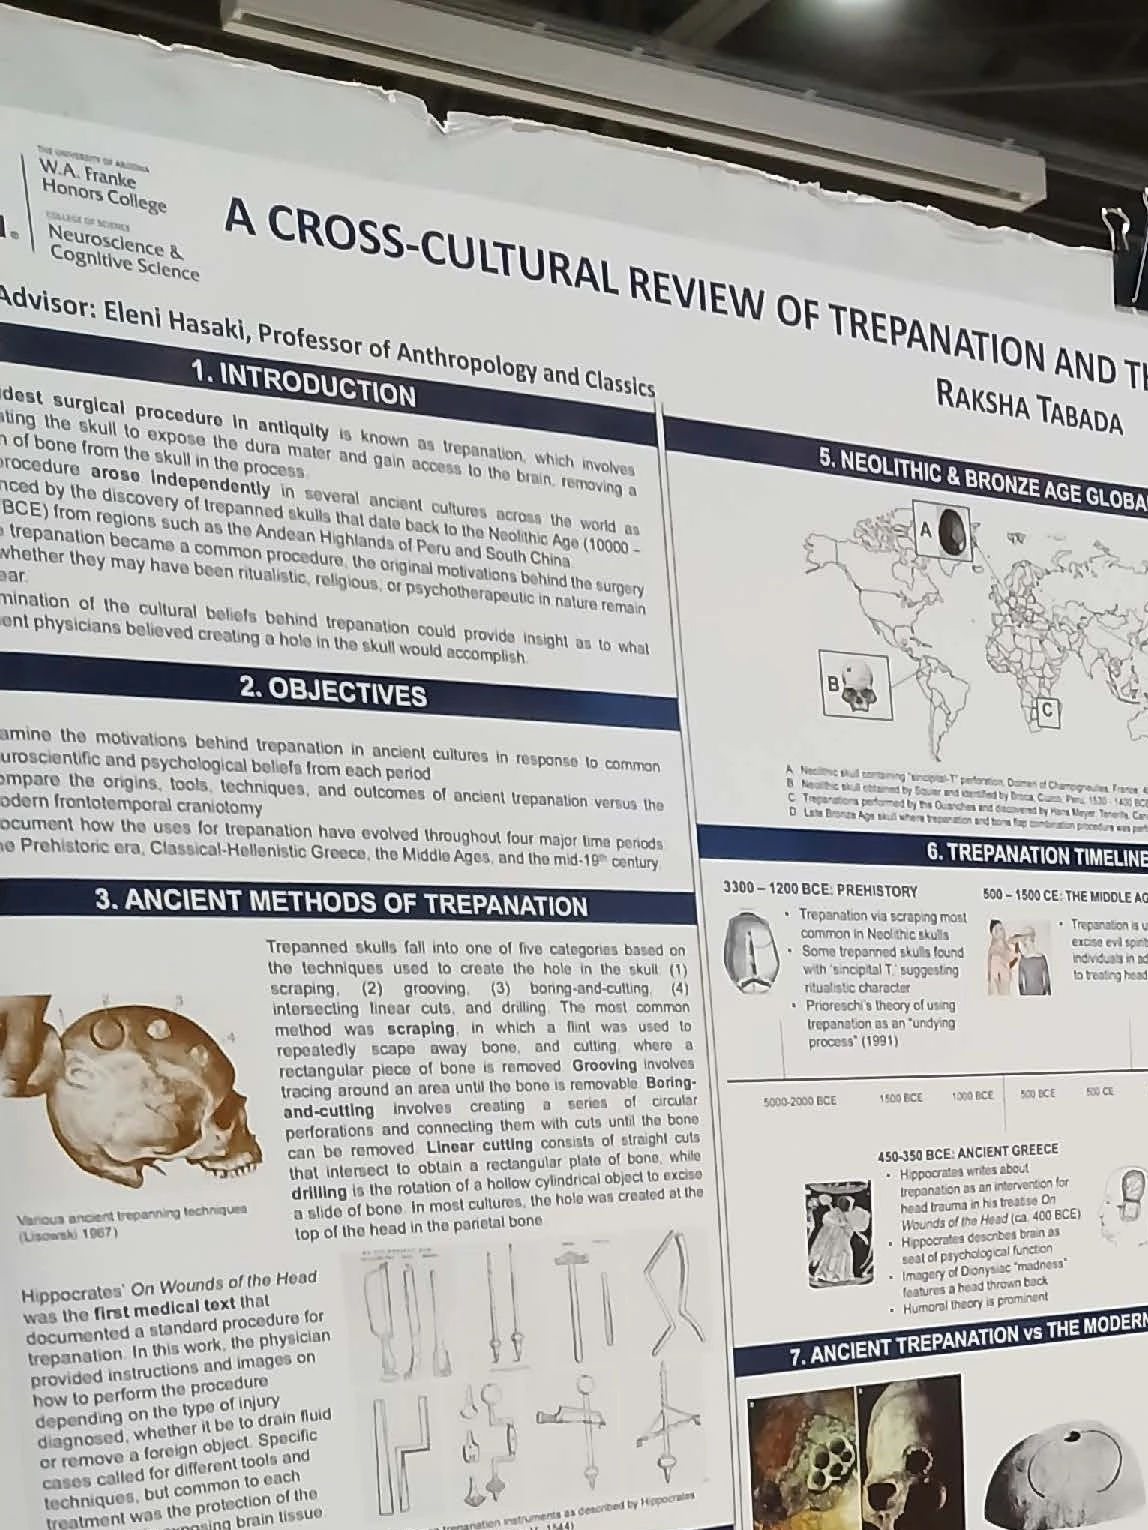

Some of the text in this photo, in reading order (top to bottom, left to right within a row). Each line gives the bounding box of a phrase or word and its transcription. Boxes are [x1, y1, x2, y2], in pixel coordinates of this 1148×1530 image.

[39, 158, 136, 189] W.A. Franke
[43, 178, 166, 215] Honors College
[48, 223, 164, 257] Neuroscience
[170, 245, 184, 261] &
[51, 244, 199, 282] Cognitive Science
[225, 197, 256, 235] A
[269, 205, 619, 295] CROSS-CULTURAL
[630, 266, 764, 320] REVIEW
[778, 295, 819, 330] OF
[828, 303, 1044, 372] TREPANATION
[1055, 347, 1116, 384] AND
[0, 285, 655, 401] Advisor: Eleni Hasaki, Professor of Anthropology and Classics
[192, 359, 415, 407] 1. INTRODUCTION
[937, 378, 1123, 436] RAKSHA TABADA
[53, 396, 124, 415] surgical
[136, 406, 223, 427] procedure
[233, 414, 248, 430] in
[259, 420, 328, 442] antiquity
[340, 429, 352, 441] is
[361, 429, 409, 448] known
[418, 439, 434, 451] as
[535, 453, 574, 468] which
[583, 460, 635, 476] involves
[820, 447, 835, 467] 5.
[841, 450, 941, 482] NEOLITHIC
[947, 466, 960, 486] &
[965, 469, 1040, 497] BRONZE
[1045, 481, 1081, 503] AGE
[920, 522, 932, 538] A
[240, 675, 427, 707] 2. OBJECTIVES
[828, 676, 840, 692] B
[1042, 702, 1053, 717] C
[928, 842, 943, 860] 6.
[947, 842, 1070, 865] TREPANATION
[95, 888, 588, 920] 3. ANCIENT METHODS OF TREPANATION
[724, 880, 754, 893] 3300
[770, 882, 798, 894] 1200
[802, 883, 833, 895] BCE:
[837, 884, 917, 898] PREHISTORY
[984, 888, 1002, 899] 500
[1016, 889, 1040, 901] 1500
[1043, 890, 1062, 901] CE:
[1065, 890, 1087, 902] THE
[1090, 891, 1132, 903] MIDDLE
[878, 1143, 1058, 1162] 450-350 BCE: ANCIENT GREECE
[131, 1282, 154, 1297] On
[160, 1277, 223, 1294] Wounds
[229, 1274, 244, 1288] of
[248, 1274, 271, 1288] the
[277, 1270, 317, 1285] Head
[24, 1294, 269, 1324] was the first medical text that
[790, 1348, 805, 1366] 7.
[811, 1339, 892, 1363] ANCIENT
[895, 1325, 1018, 1354] TREPANATION
[1024, 1327, 1042, 1340] vs
[1046, 1319, 1080, 1338] THE
